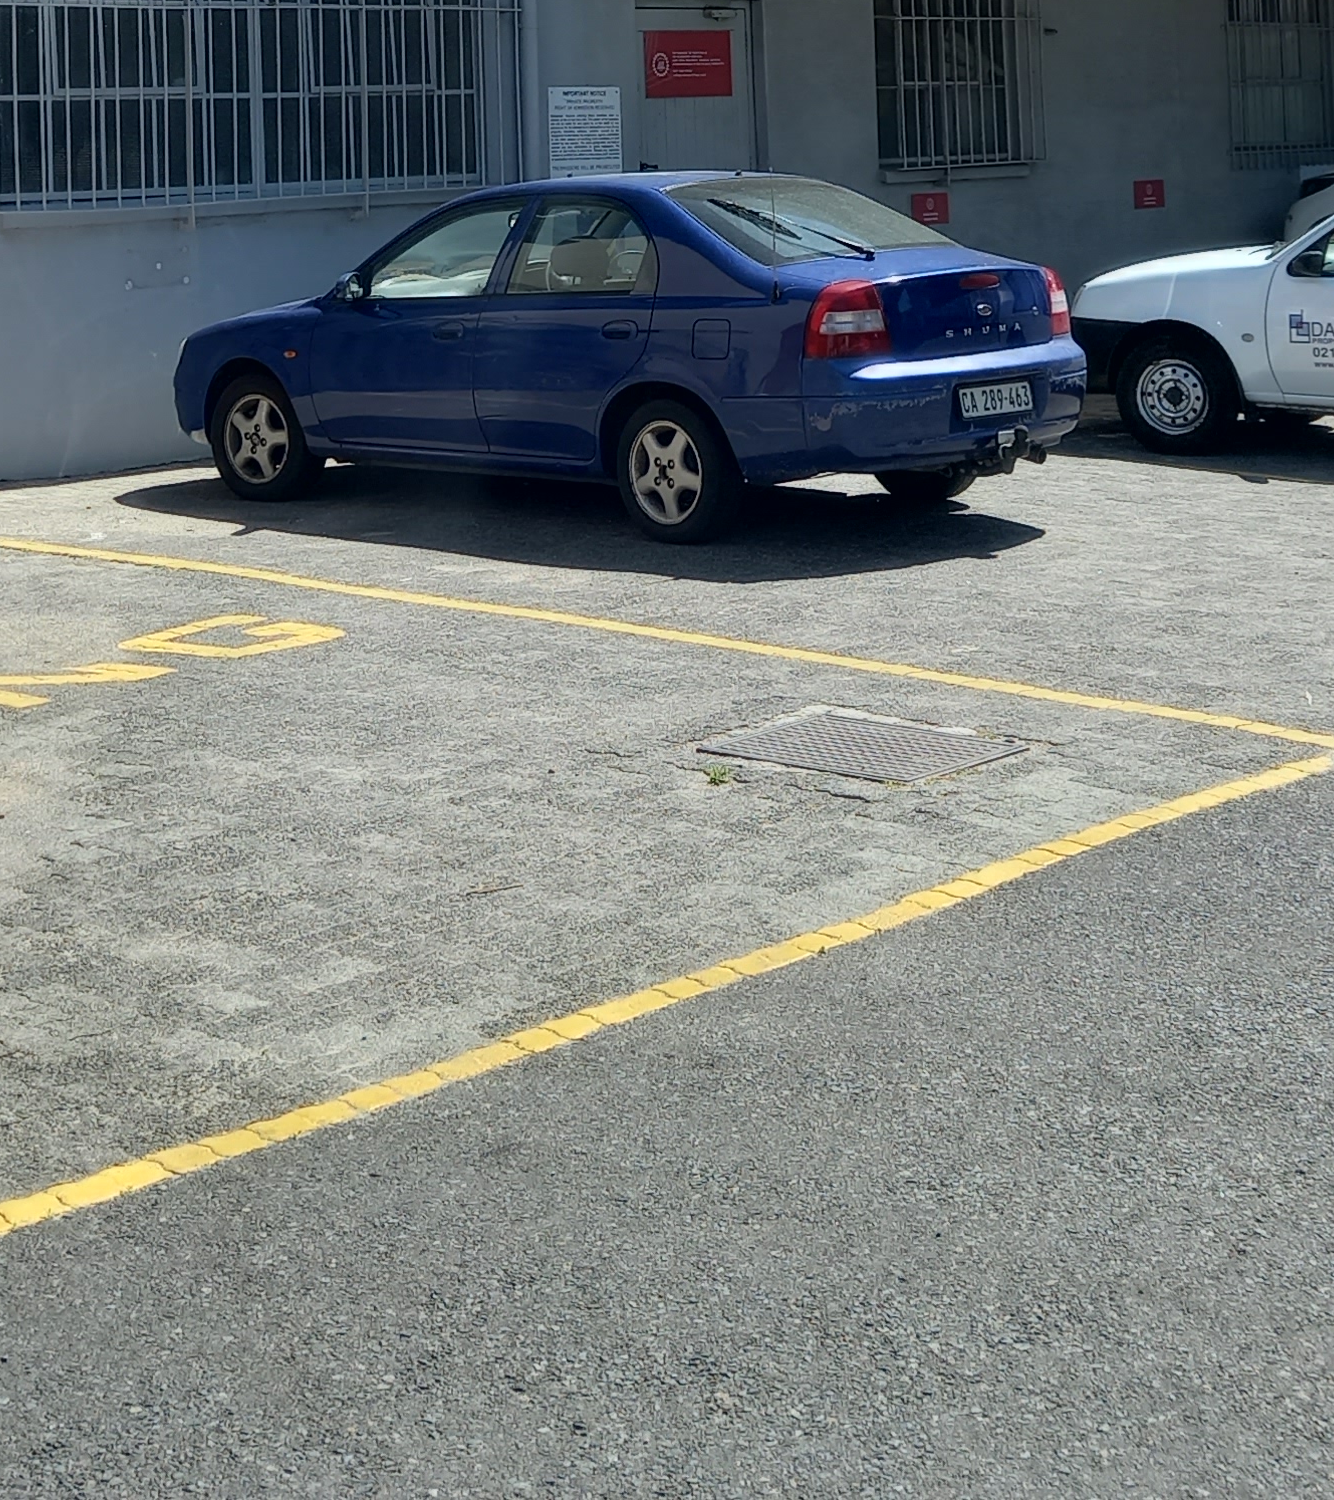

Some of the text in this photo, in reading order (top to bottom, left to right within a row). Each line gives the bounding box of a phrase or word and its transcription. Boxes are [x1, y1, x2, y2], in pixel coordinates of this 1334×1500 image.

[946, 322, 1021, 338] SHUMA
[1312, 347, 1334, 358] 021
[962, 385, 1030, 413] CA 289-463
